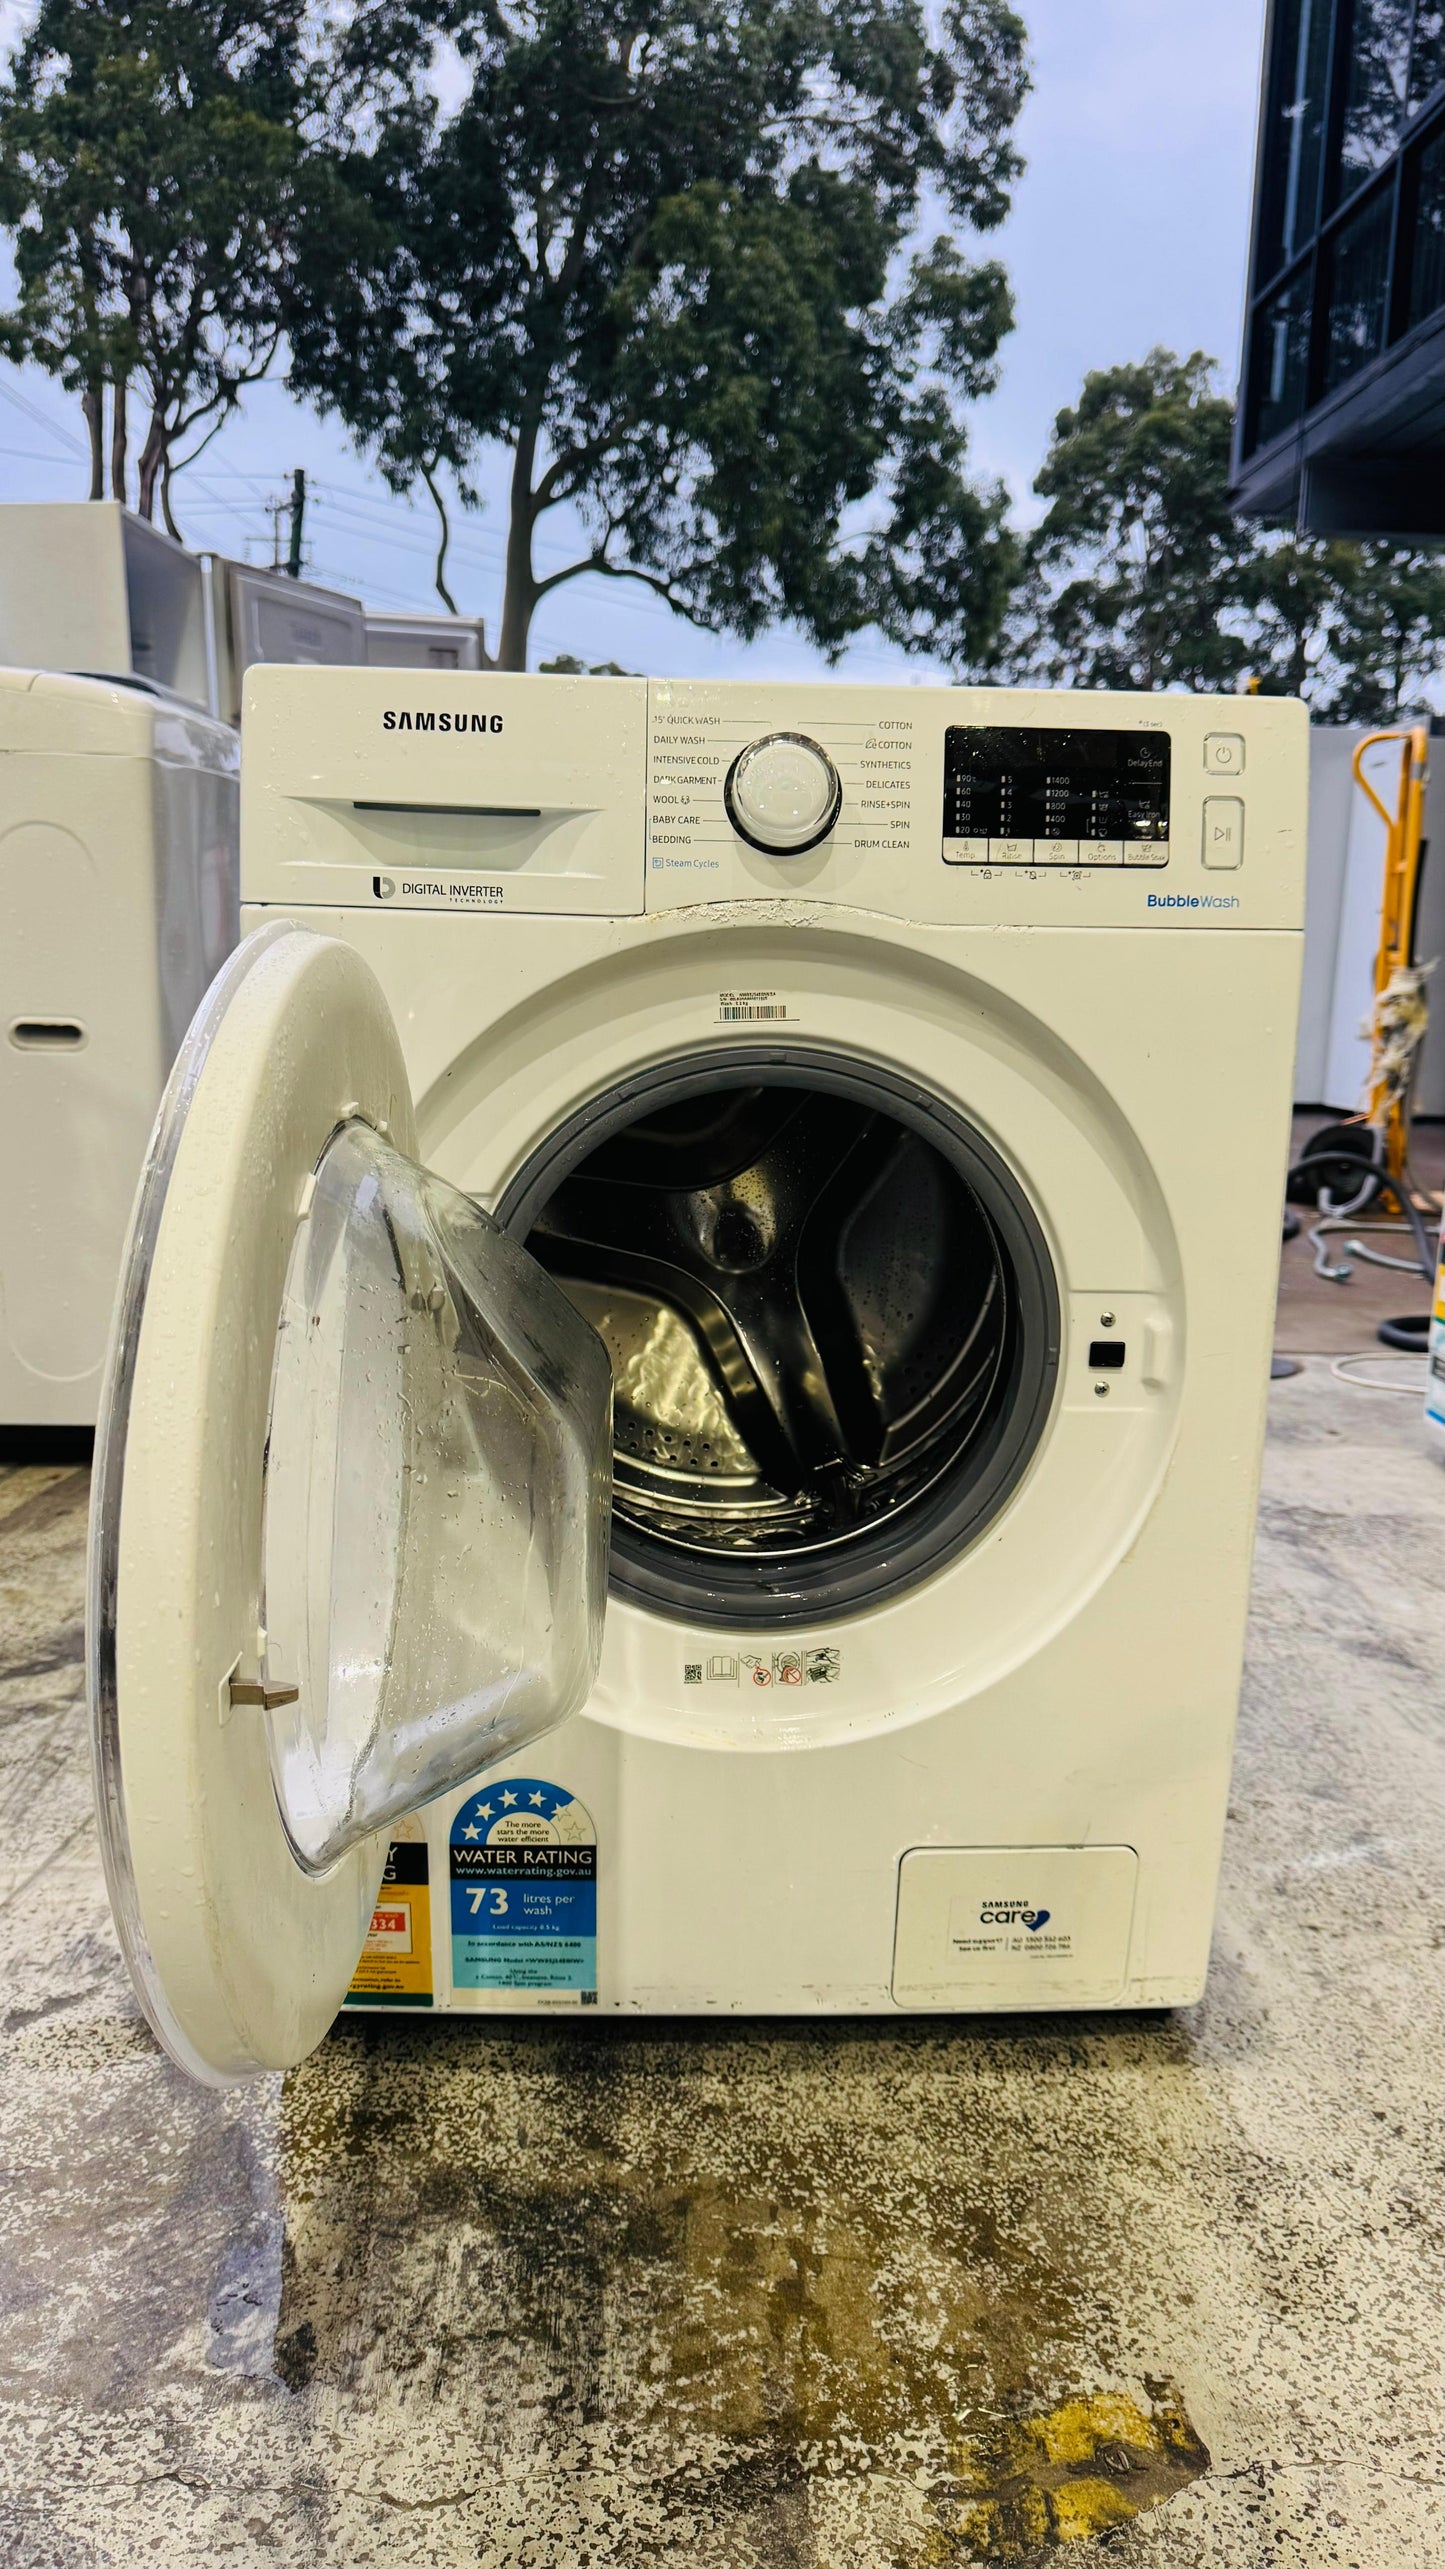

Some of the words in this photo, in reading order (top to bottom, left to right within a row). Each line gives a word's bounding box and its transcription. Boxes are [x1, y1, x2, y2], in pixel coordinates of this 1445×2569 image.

[383, 710, 504, 733] SAMSUNG
[667, 714, 694, 725] QUICK
[695, 716, 721, 725] WASH
[878, 720, 913, 730] COTTON
[653, 735, 678, 744] DAILY
[680, 736, 706, 744] WASH
[878, 741, 912, 750] COTTON
[653, 755, 696, 765] INTENSIVE
[697, 756, 720, 765] COLD
[860, 760, 912, 770] SYNTHETICS
[677, 775, 717, 785] GARMENT
[1007, 776, 1013, 784] 5
[1052, 776, 1070, 785] 1400
[865, 780, 911, 790] DELICATES
[961, 787, 971, 795] 60
[1006, 788, 1013, 796] 4
[1051, 789, 1070, 798] 1200
[653, 795, 679, 804] WOOL
[860, 800, 911, 809] RINSE+SPIN
[961, 800, 971, 809] 40
[1007, 801, 1013, 809] 3
[1050, 802, 1066, 810] 800
[652, 815, 676, 824] BABY
[677, 815, 701, 825] CARE
[960, 813, 971, 821] 30
[1006, 814, 1012, 822] 2
[1050, 815, 1066, 823] 400
[890, 820, 910, 829] SPIN
[960, 826, 970, 834] 20
[652, 835, 692, 844] BEDDING
[854, 839, 880, 848] DRUM
[881, 840, 910, 849] CLEAN
[1048, 852, 1066, 861] Spin
[1087, 853, 1117, 862] Options
[1127, 853, 1150, 861] Bubble
[665, 858, 692, 868] Steam
[693, 859, 720, 869] Cycles
[402, 883, 446, 896] DIGITAL
[449, 884, 504, 898] INVERTER
[1147, 894, 1240, 909] BubbleWash
[504, 1820, 520, 1829] The
[521, 1821, 542, 1829] more
[496, 1828, 515, 1836] stars
[515, 1828, 528, 1836] the
[453, 1849, 518, 1864] WATER
[523, 1850, 593, 1865] RATING
[455, 1866, 592, 1878] www.waterrating.gov.au
[465, 1887, 509, 1916] 73
[523, 1893, 552, 1904] litres
[555, 1895, 575, 1906] per
[981, 1900, 1029, 1908] SAMSUNG
[523, 1904, 552, 1915] wash
[980, 1909, 1036, 1925] care
